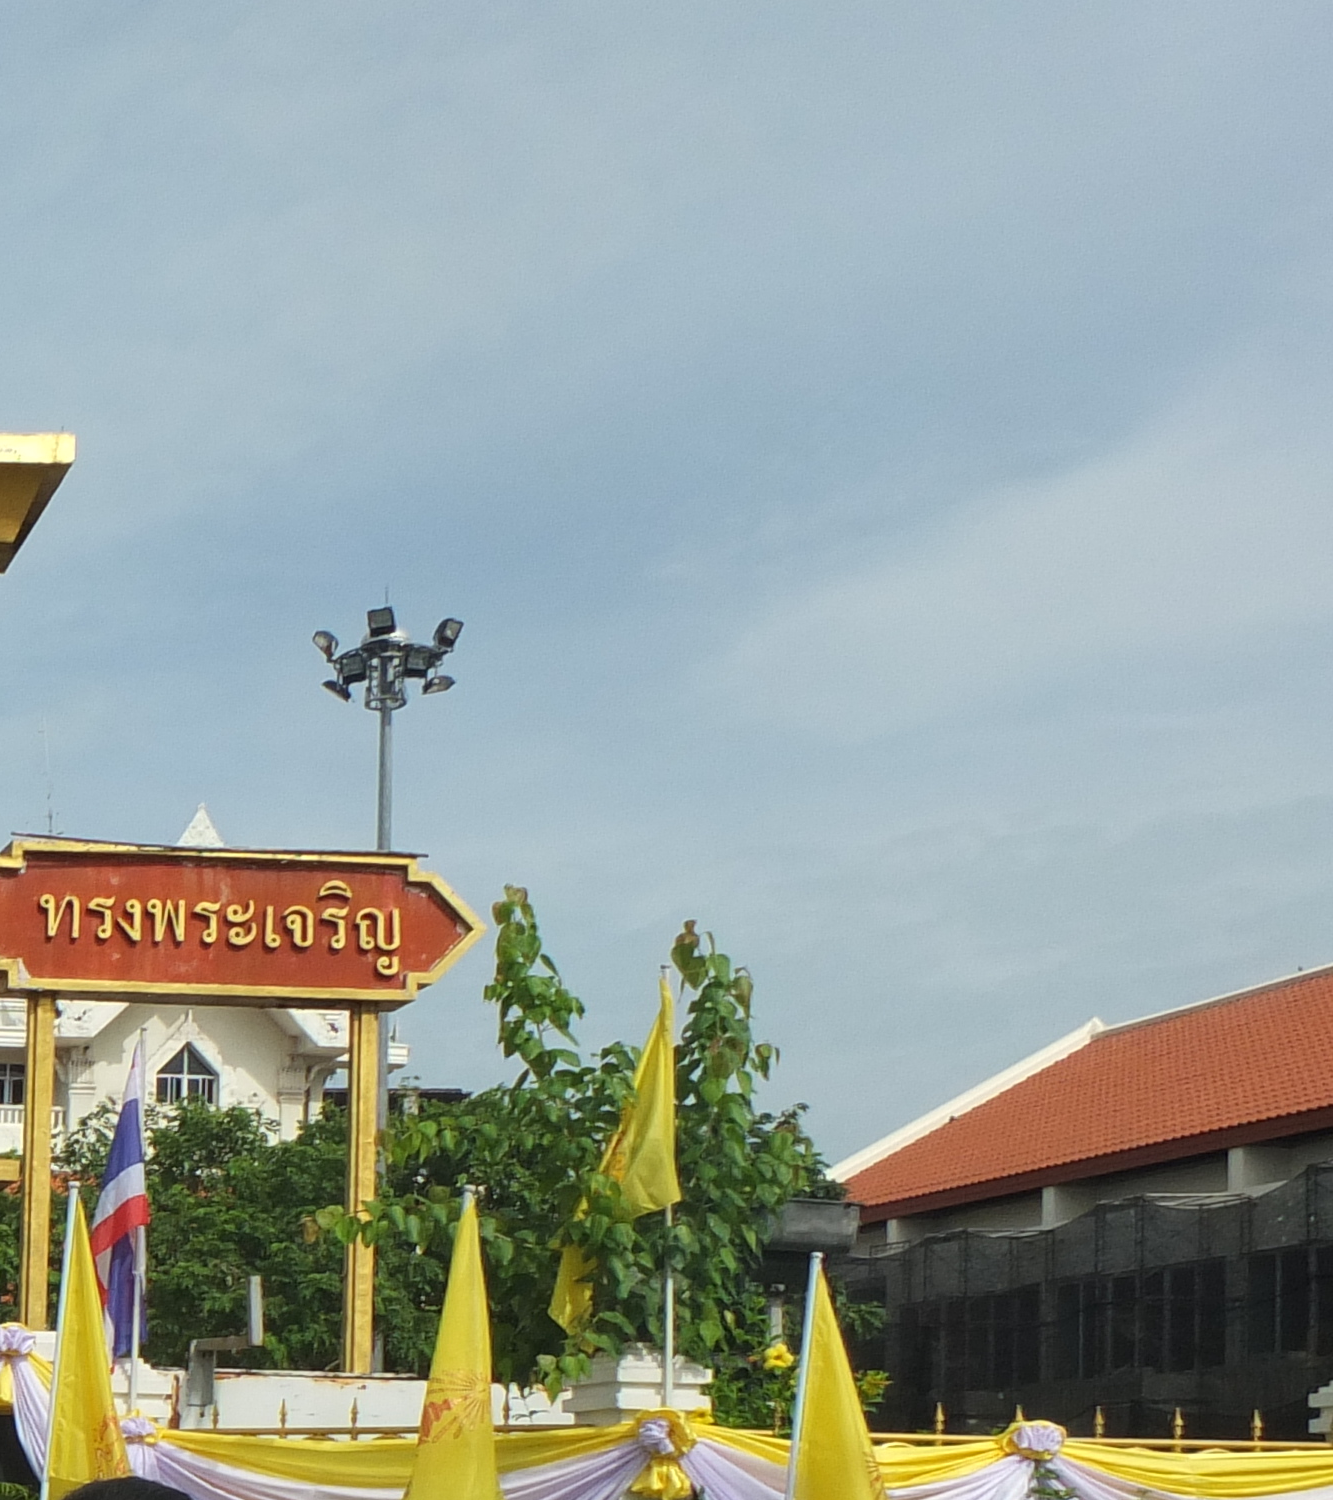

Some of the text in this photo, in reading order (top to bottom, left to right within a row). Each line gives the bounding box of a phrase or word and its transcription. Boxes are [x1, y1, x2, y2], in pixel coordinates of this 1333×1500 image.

[39, 879, 402, 977] ทรงพระเจริญ
